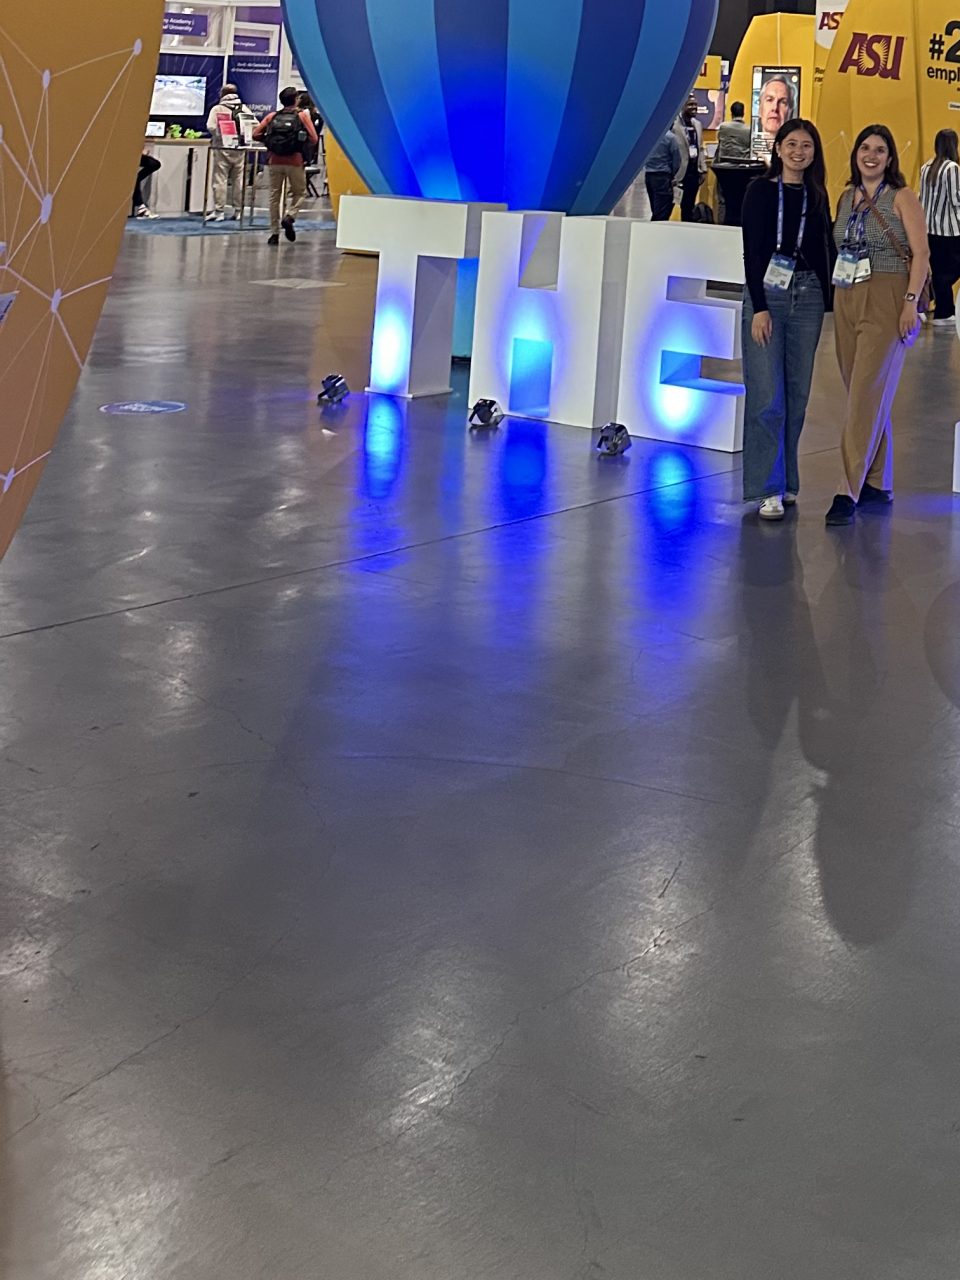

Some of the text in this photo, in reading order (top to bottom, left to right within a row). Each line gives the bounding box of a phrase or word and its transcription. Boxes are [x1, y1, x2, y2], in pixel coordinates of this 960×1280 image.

[819, 12, 844, 30] AS
[838, 32, 901, 80] ASU
[336, 195, 744, 453] THE
